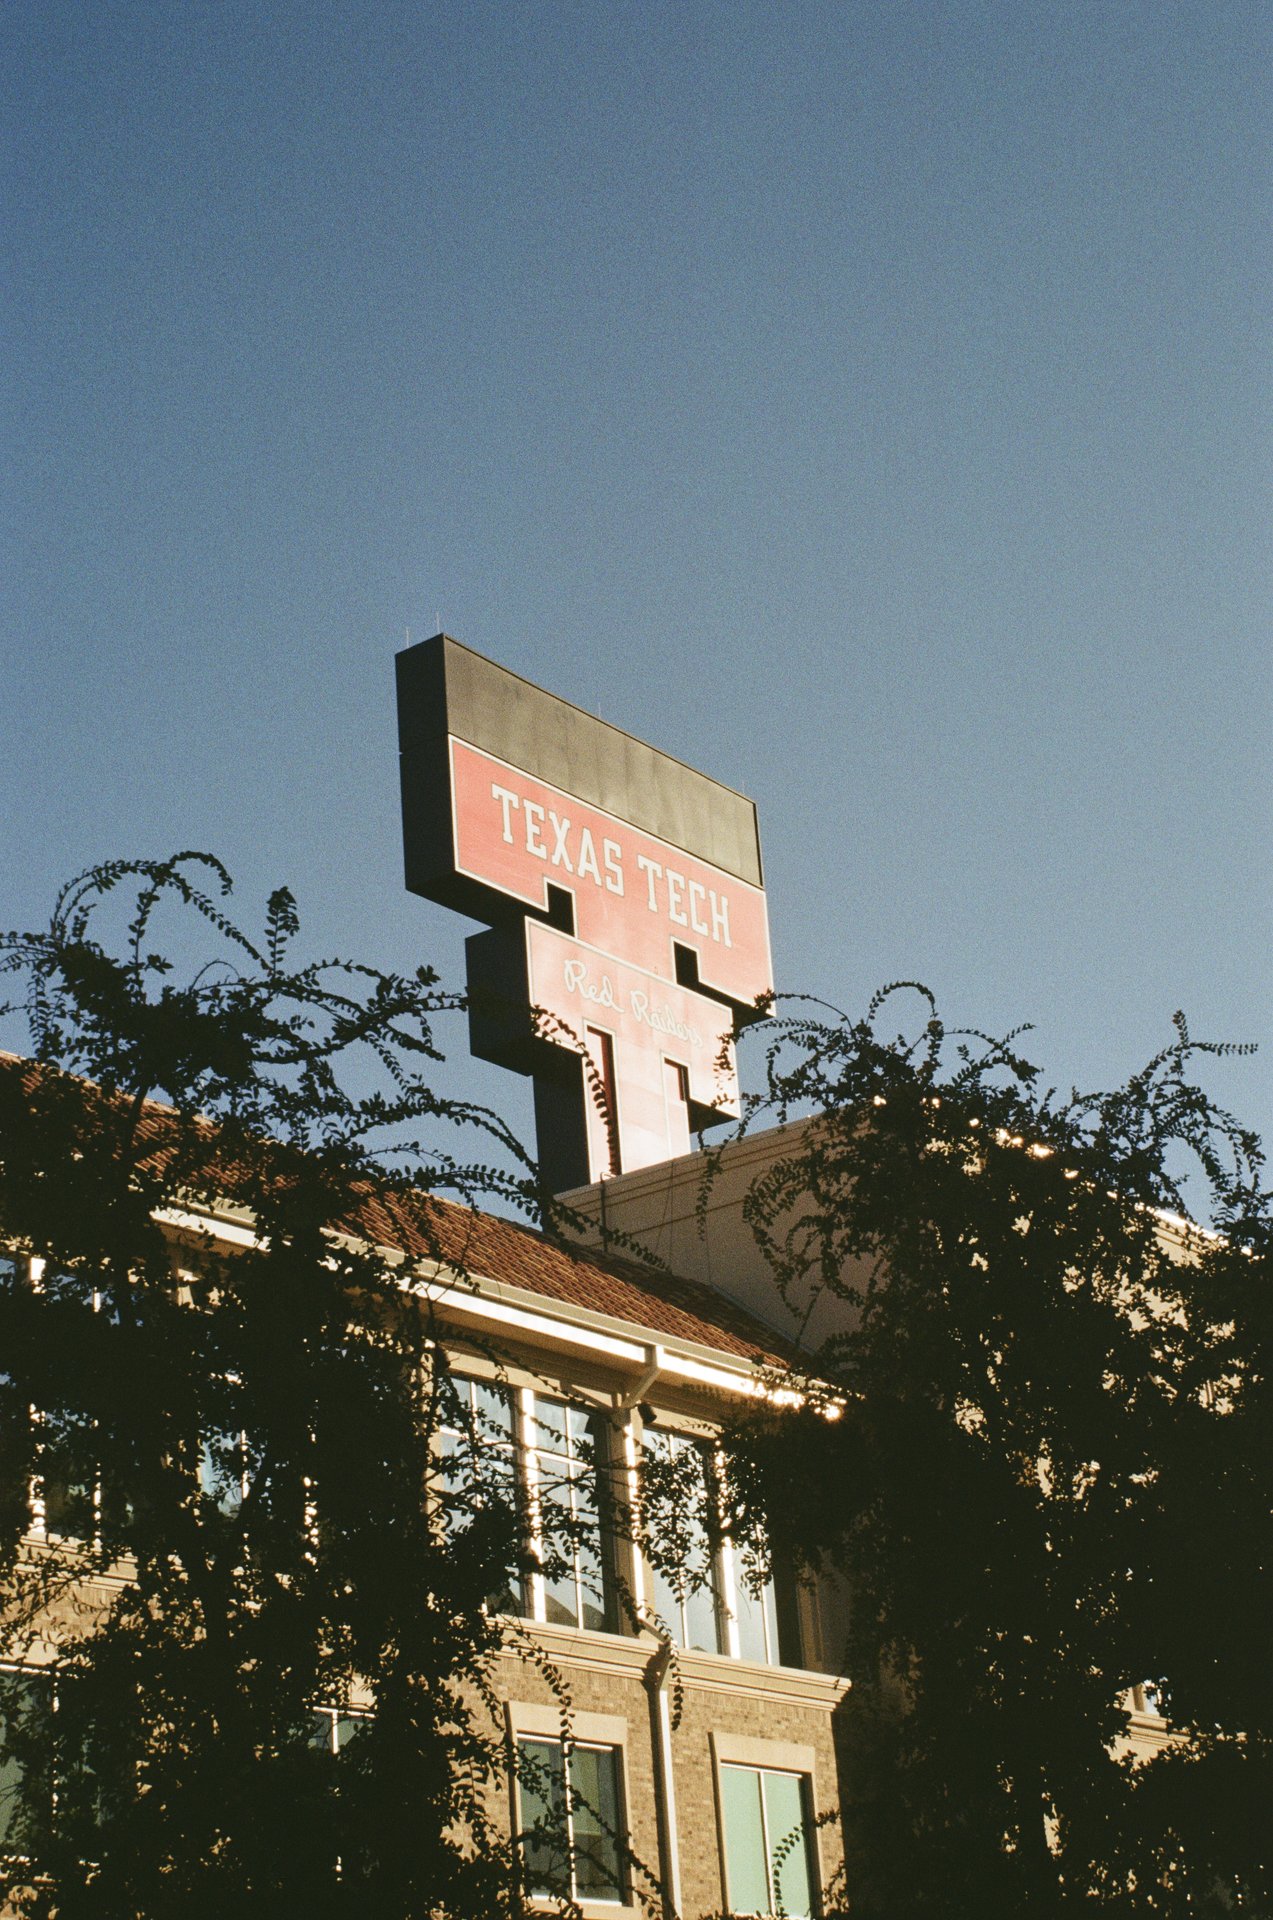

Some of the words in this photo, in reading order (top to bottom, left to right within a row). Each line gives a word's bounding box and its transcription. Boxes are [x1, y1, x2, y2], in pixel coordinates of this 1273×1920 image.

[491, 783, 624, 897] TEXAS
[637, 854, 732, 948] TECH
[564, 959, 624, 1013] Red
